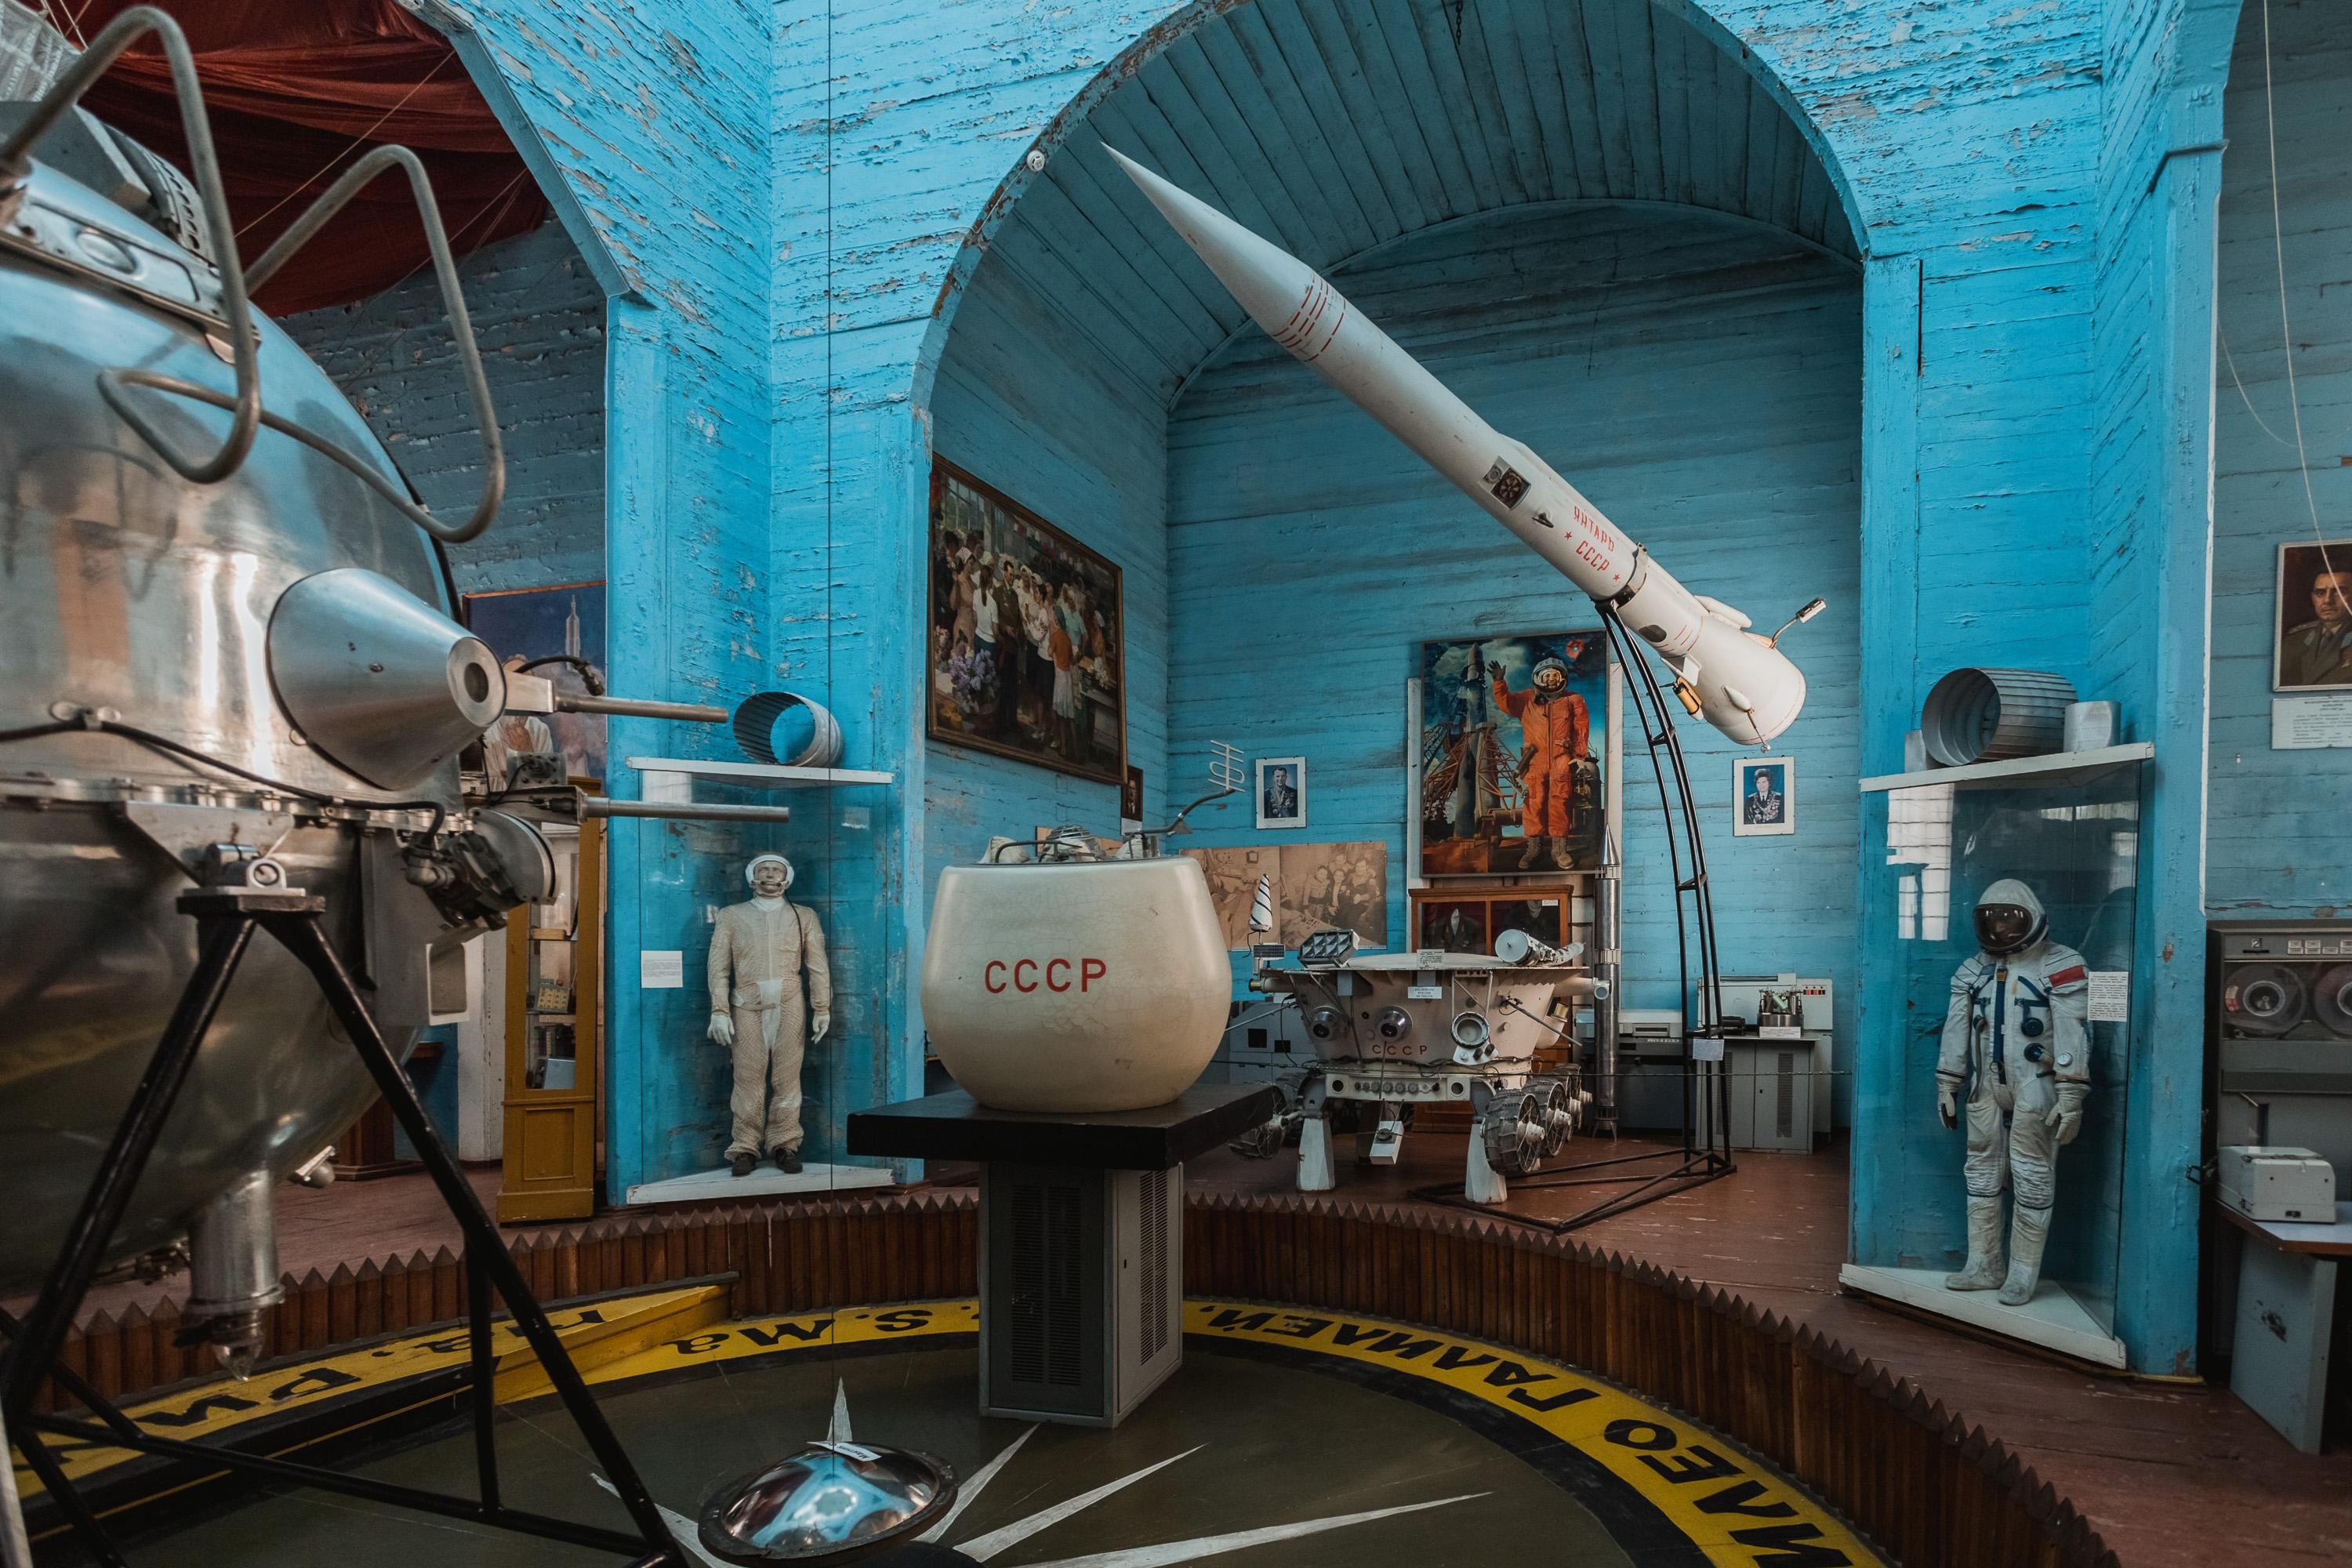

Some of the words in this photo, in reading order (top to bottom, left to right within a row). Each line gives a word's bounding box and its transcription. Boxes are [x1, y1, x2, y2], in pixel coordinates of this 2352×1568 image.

[1573, 506, 1615, 553] ЯНТАРЬ
[1576, 540, 1610, 572] СССР
[2252, 939, 2259, 949] 2
[985, 958, 1107, 994] СССР
[1372, 1044, 1427, 1055] СССР
[1200, 1305, 1601, 1412] ГАЛИЛЕЙ,
